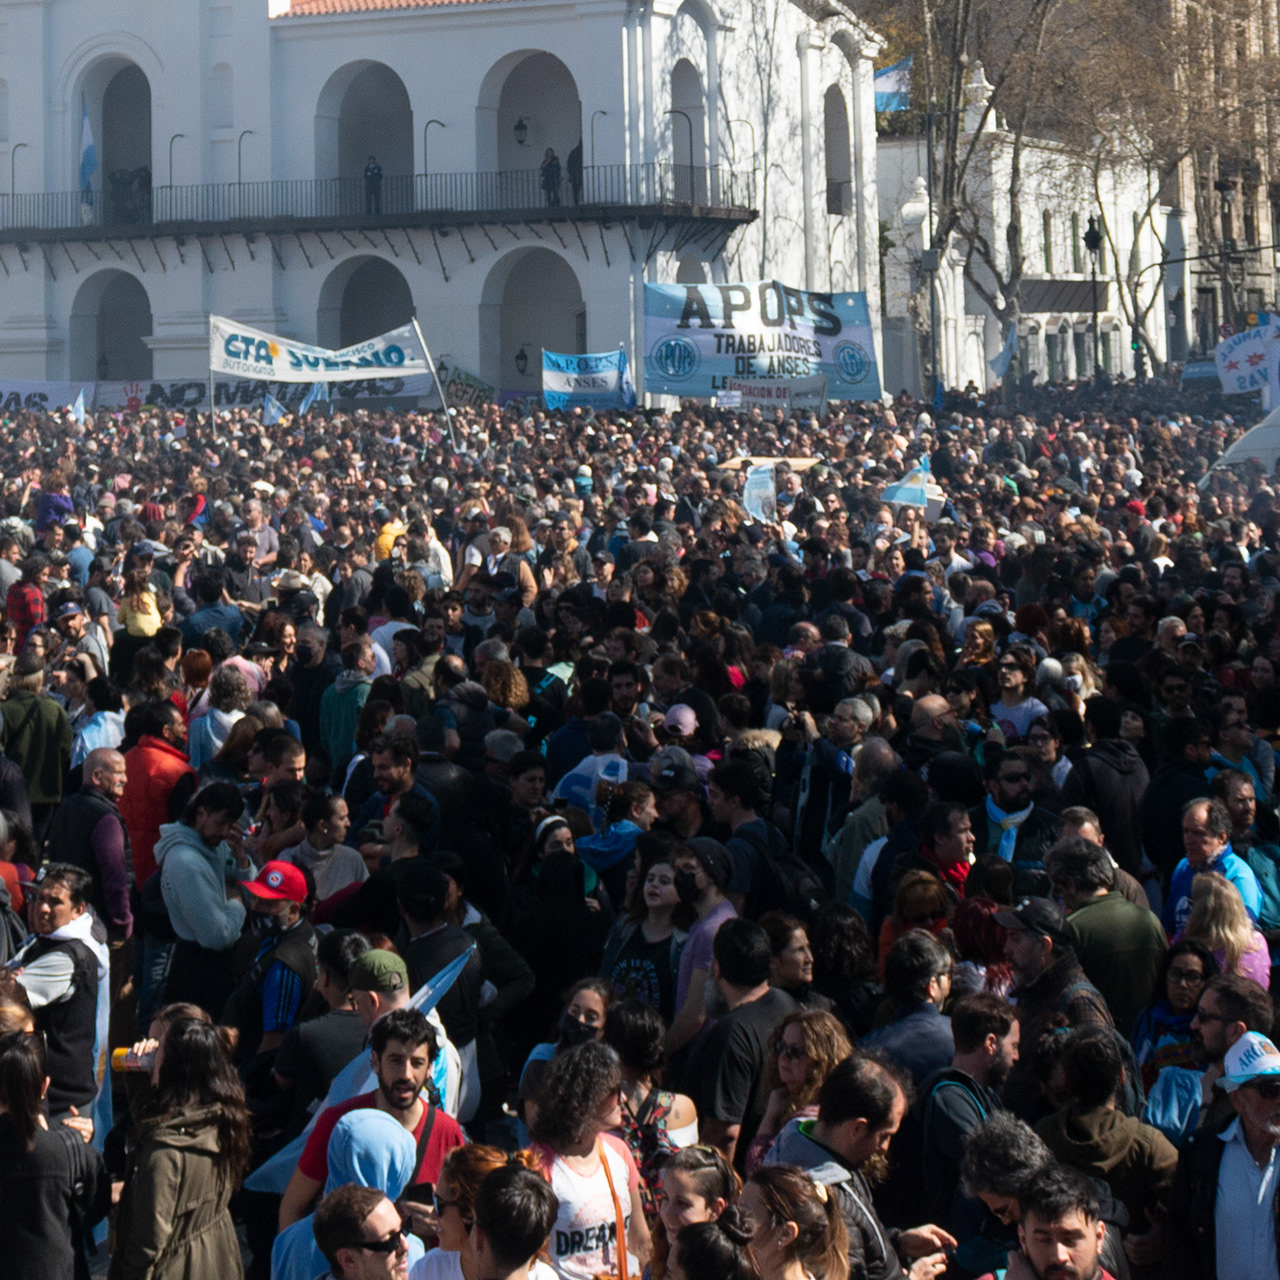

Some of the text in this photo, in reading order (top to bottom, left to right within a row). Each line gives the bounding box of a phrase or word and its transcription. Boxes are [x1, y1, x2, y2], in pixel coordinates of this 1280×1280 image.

[677, 281, 842, 336] APOPS
[224, 333, 274, 365] CTA
[713, 333, 823, 358] TRABAJADORES
[735, 356, 810, 376] DE ANSES
[145, 382, 206, 407] NO
